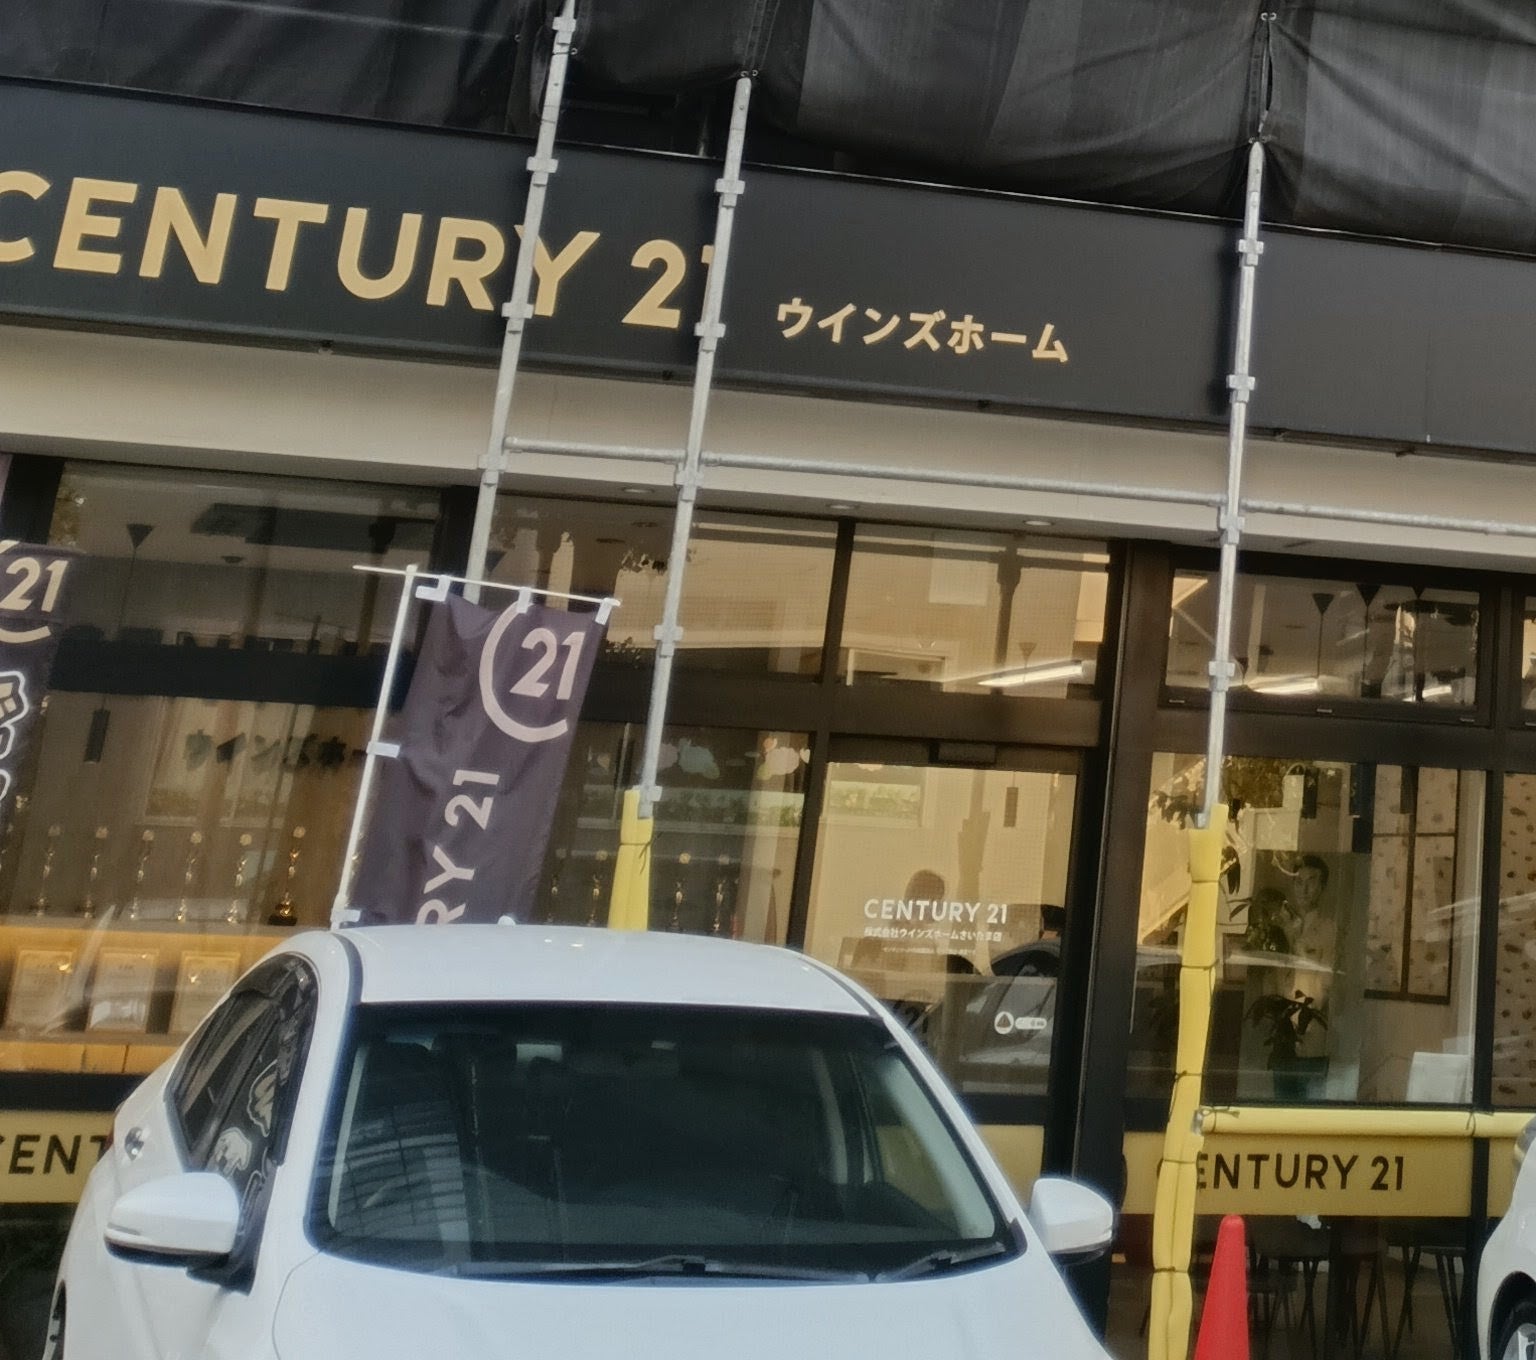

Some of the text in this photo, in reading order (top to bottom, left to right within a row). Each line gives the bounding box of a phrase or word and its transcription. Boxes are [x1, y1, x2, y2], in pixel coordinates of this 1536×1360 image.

[776, 297, 1069, 364] ウインズホーム
[444, 769, 501, 830] 21
[864, 898, 1008, 925] CENTURY 21
[1157, 1150, 1404, 1192] ENTURY 21
